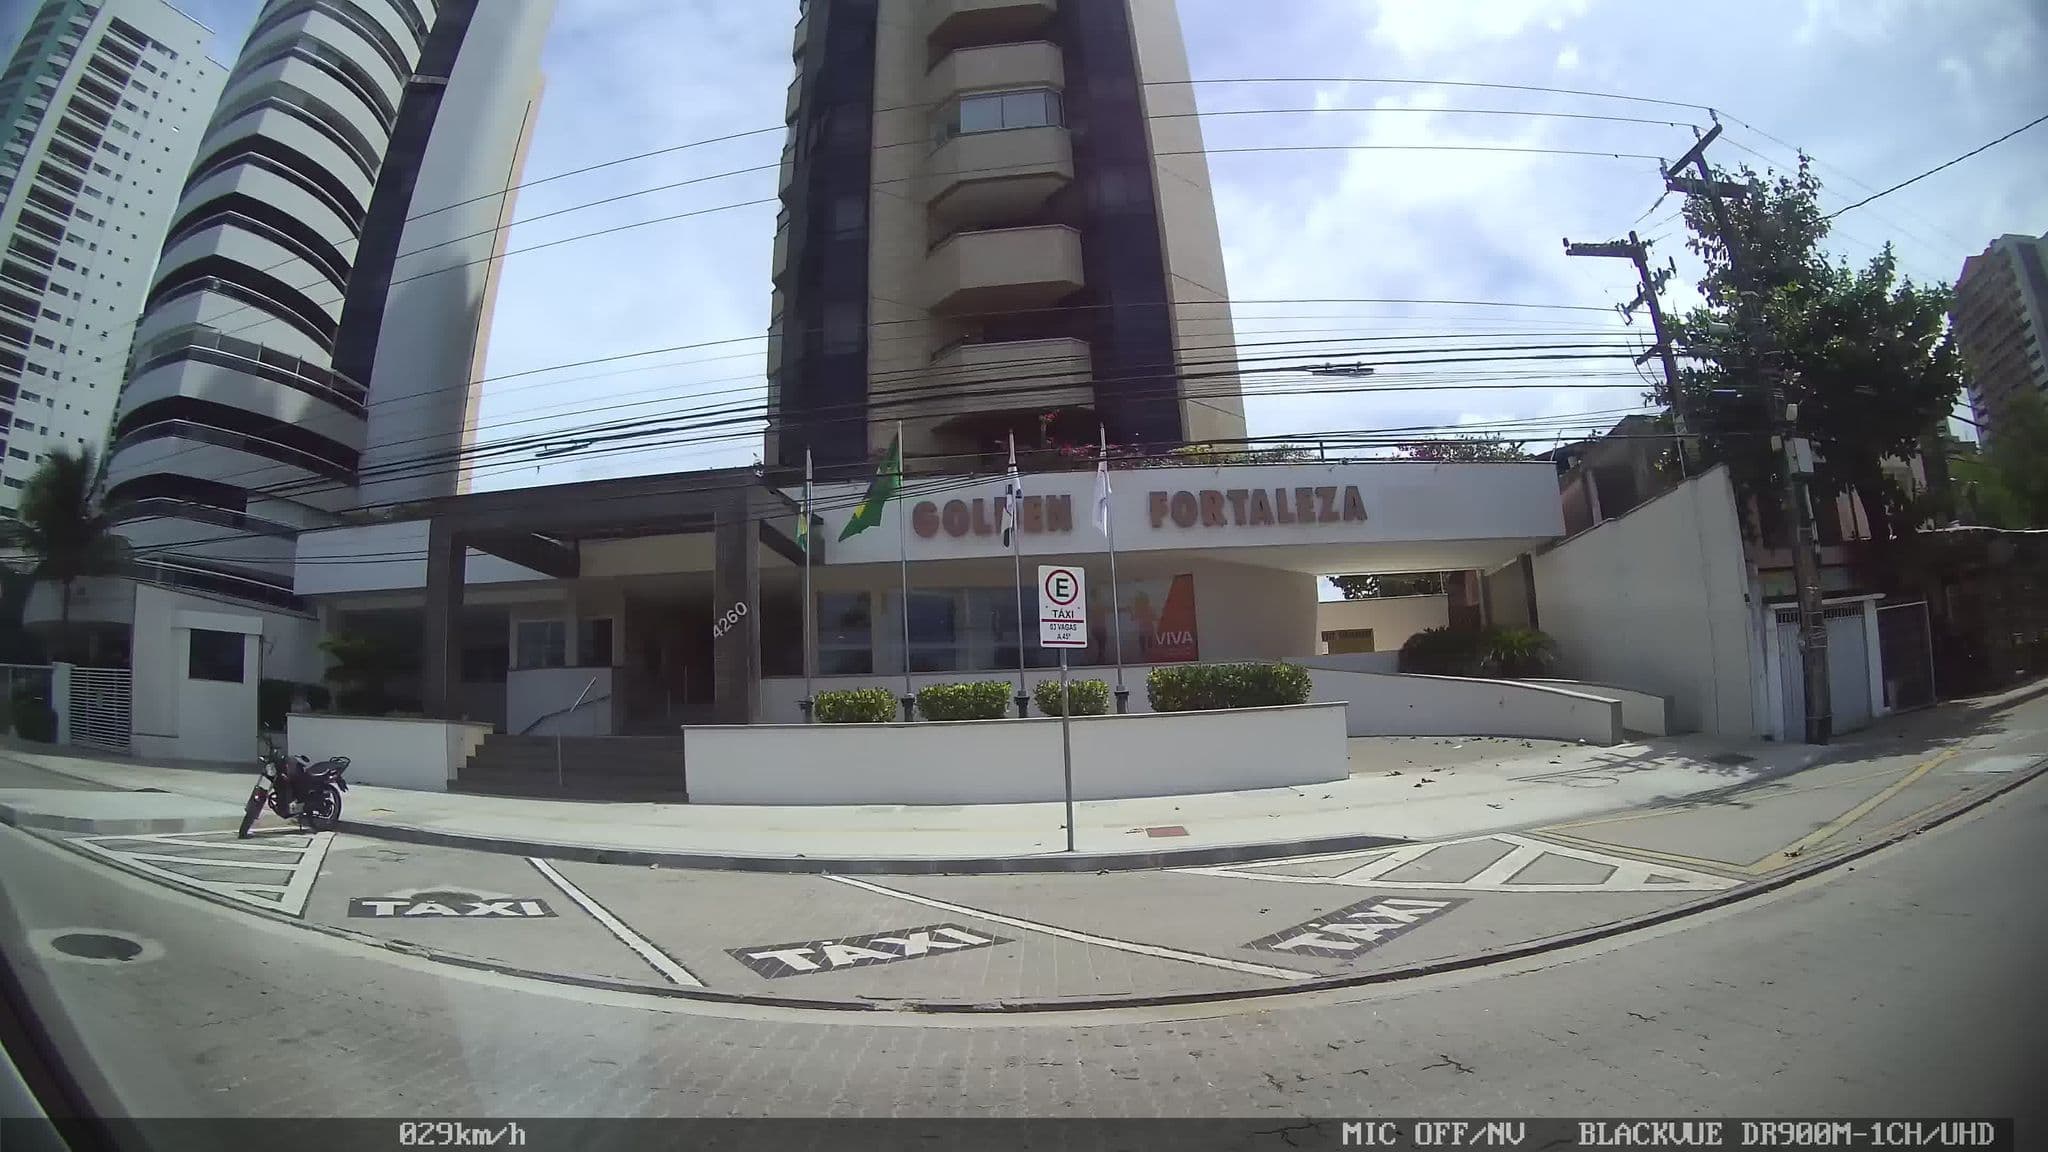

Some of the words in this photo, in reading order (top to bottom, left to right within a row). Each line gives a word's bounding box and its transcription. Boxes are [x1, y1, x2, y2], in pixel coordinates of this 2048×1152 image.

[1149, 485, 1368, 529] FORTALEZA
[1055, 578, 1069, 598] E
[713, 602, 748, 639] 4260
[1155, 631, 1193, 645] VIVA
